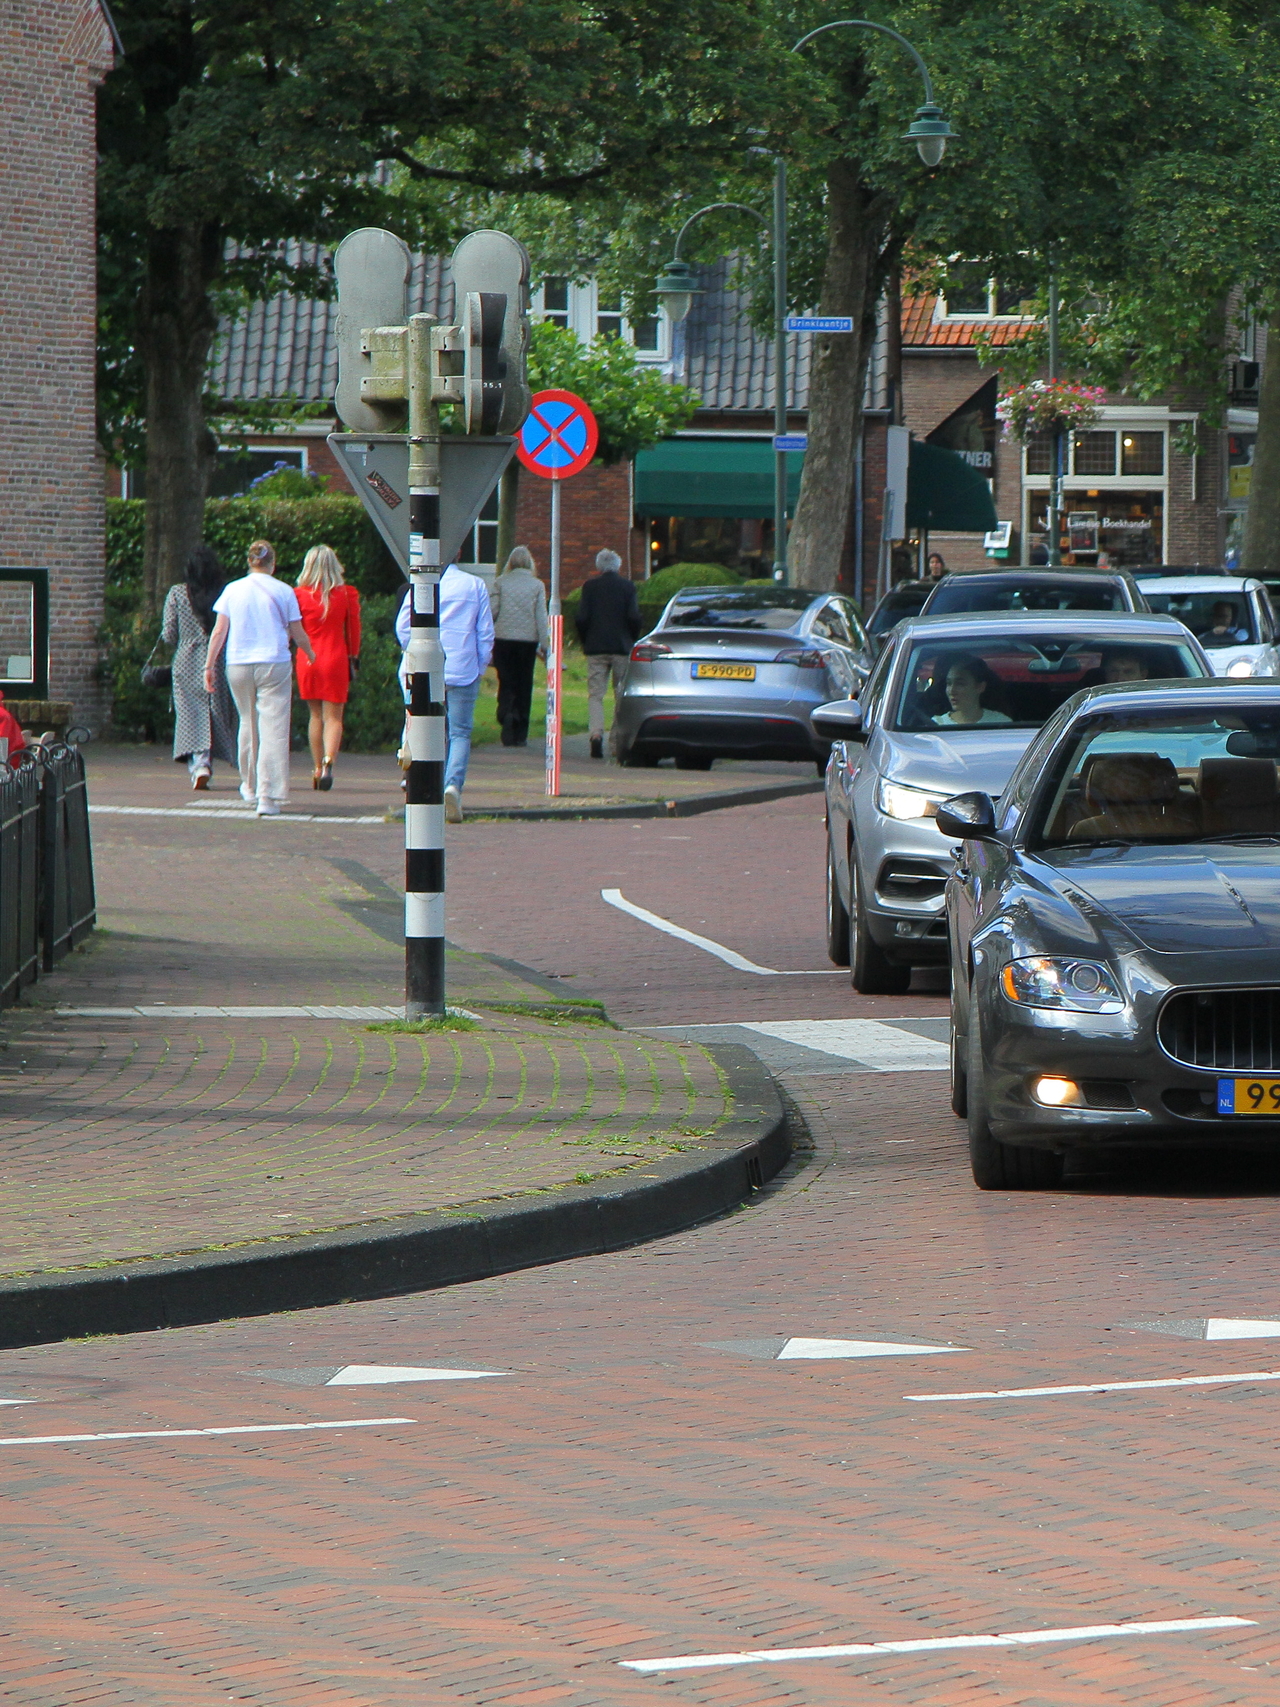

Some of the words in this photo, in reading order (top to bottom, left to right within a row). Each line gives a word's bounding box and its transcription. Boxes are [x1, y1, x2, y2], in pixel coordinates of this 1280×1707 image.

[790, 319, 849, 330] Brinklaantje
[700, 665, 752, 677] S-990-PD
[1220, 1099, 1233, 1107] NL
